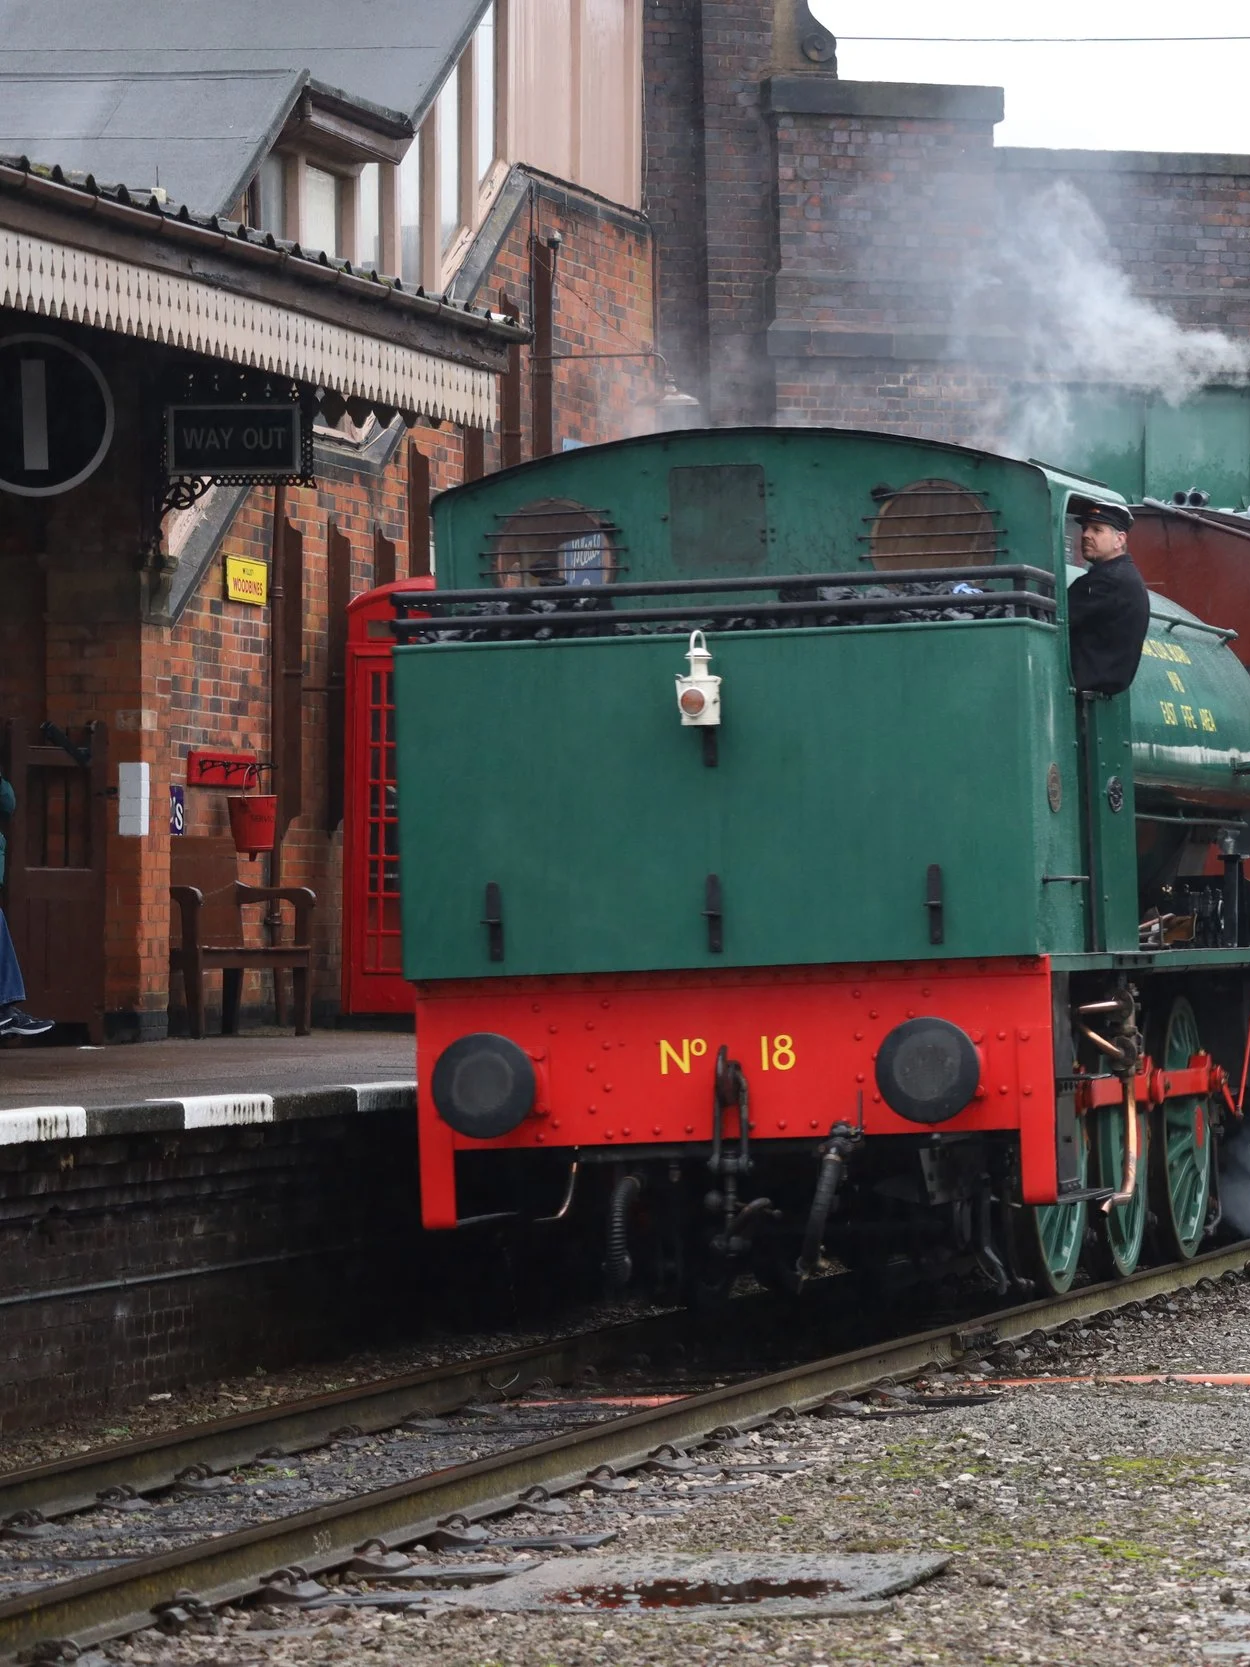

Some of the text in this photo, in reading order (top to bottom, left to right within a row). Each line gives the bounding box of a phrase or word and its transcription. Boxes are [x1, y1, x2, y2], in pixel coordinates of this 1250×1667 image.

[183, 426, 287, 450] WAY OUT
[232, 577, 263, 596] WOODBINES
[761, 1034, 796, 1071] 18
